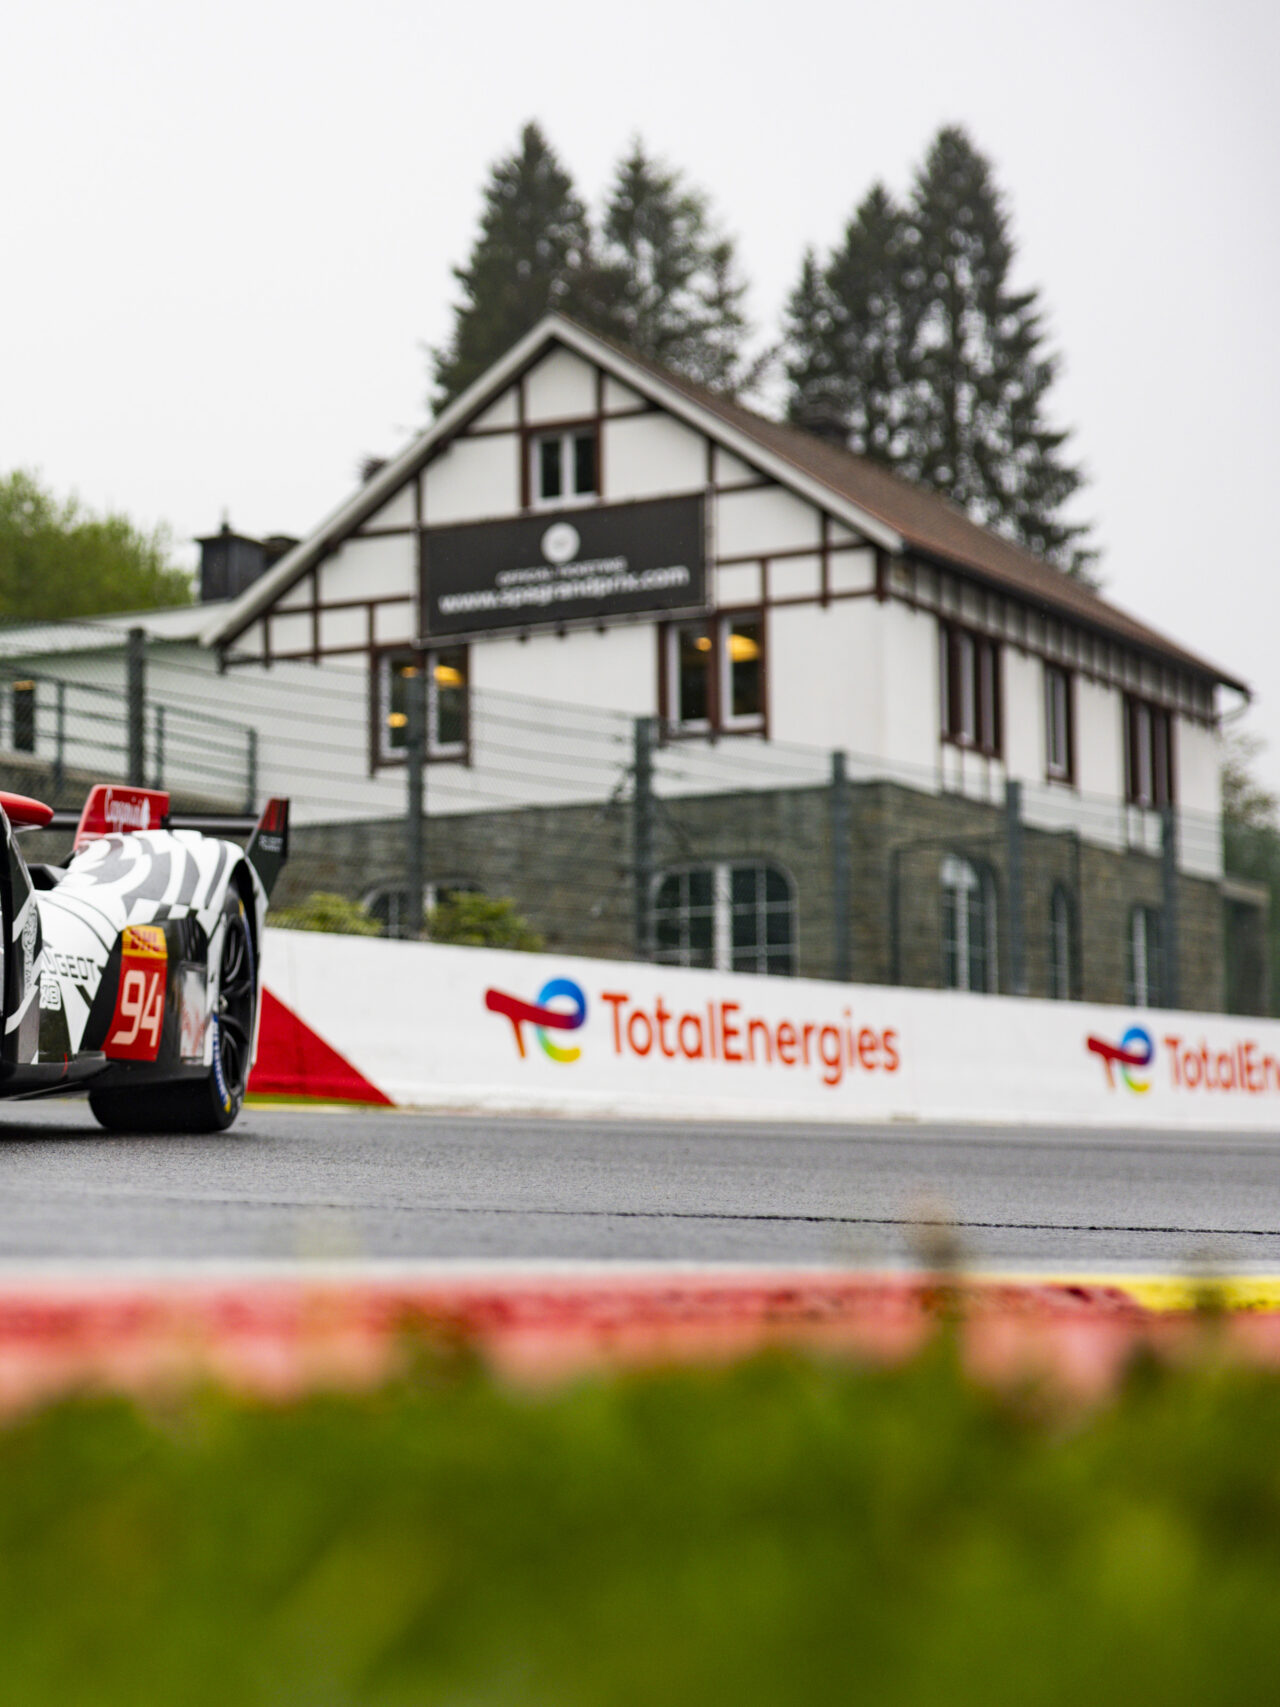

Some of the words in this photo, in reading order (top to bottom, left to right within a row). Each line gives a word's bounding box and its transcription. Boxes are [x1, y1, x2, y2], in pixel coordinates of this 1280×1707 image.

[130, 929, 160, 952] DHL
[111, 969, 163, 1048] 94
[601, 991, 902, 1087] TotalEnergies
